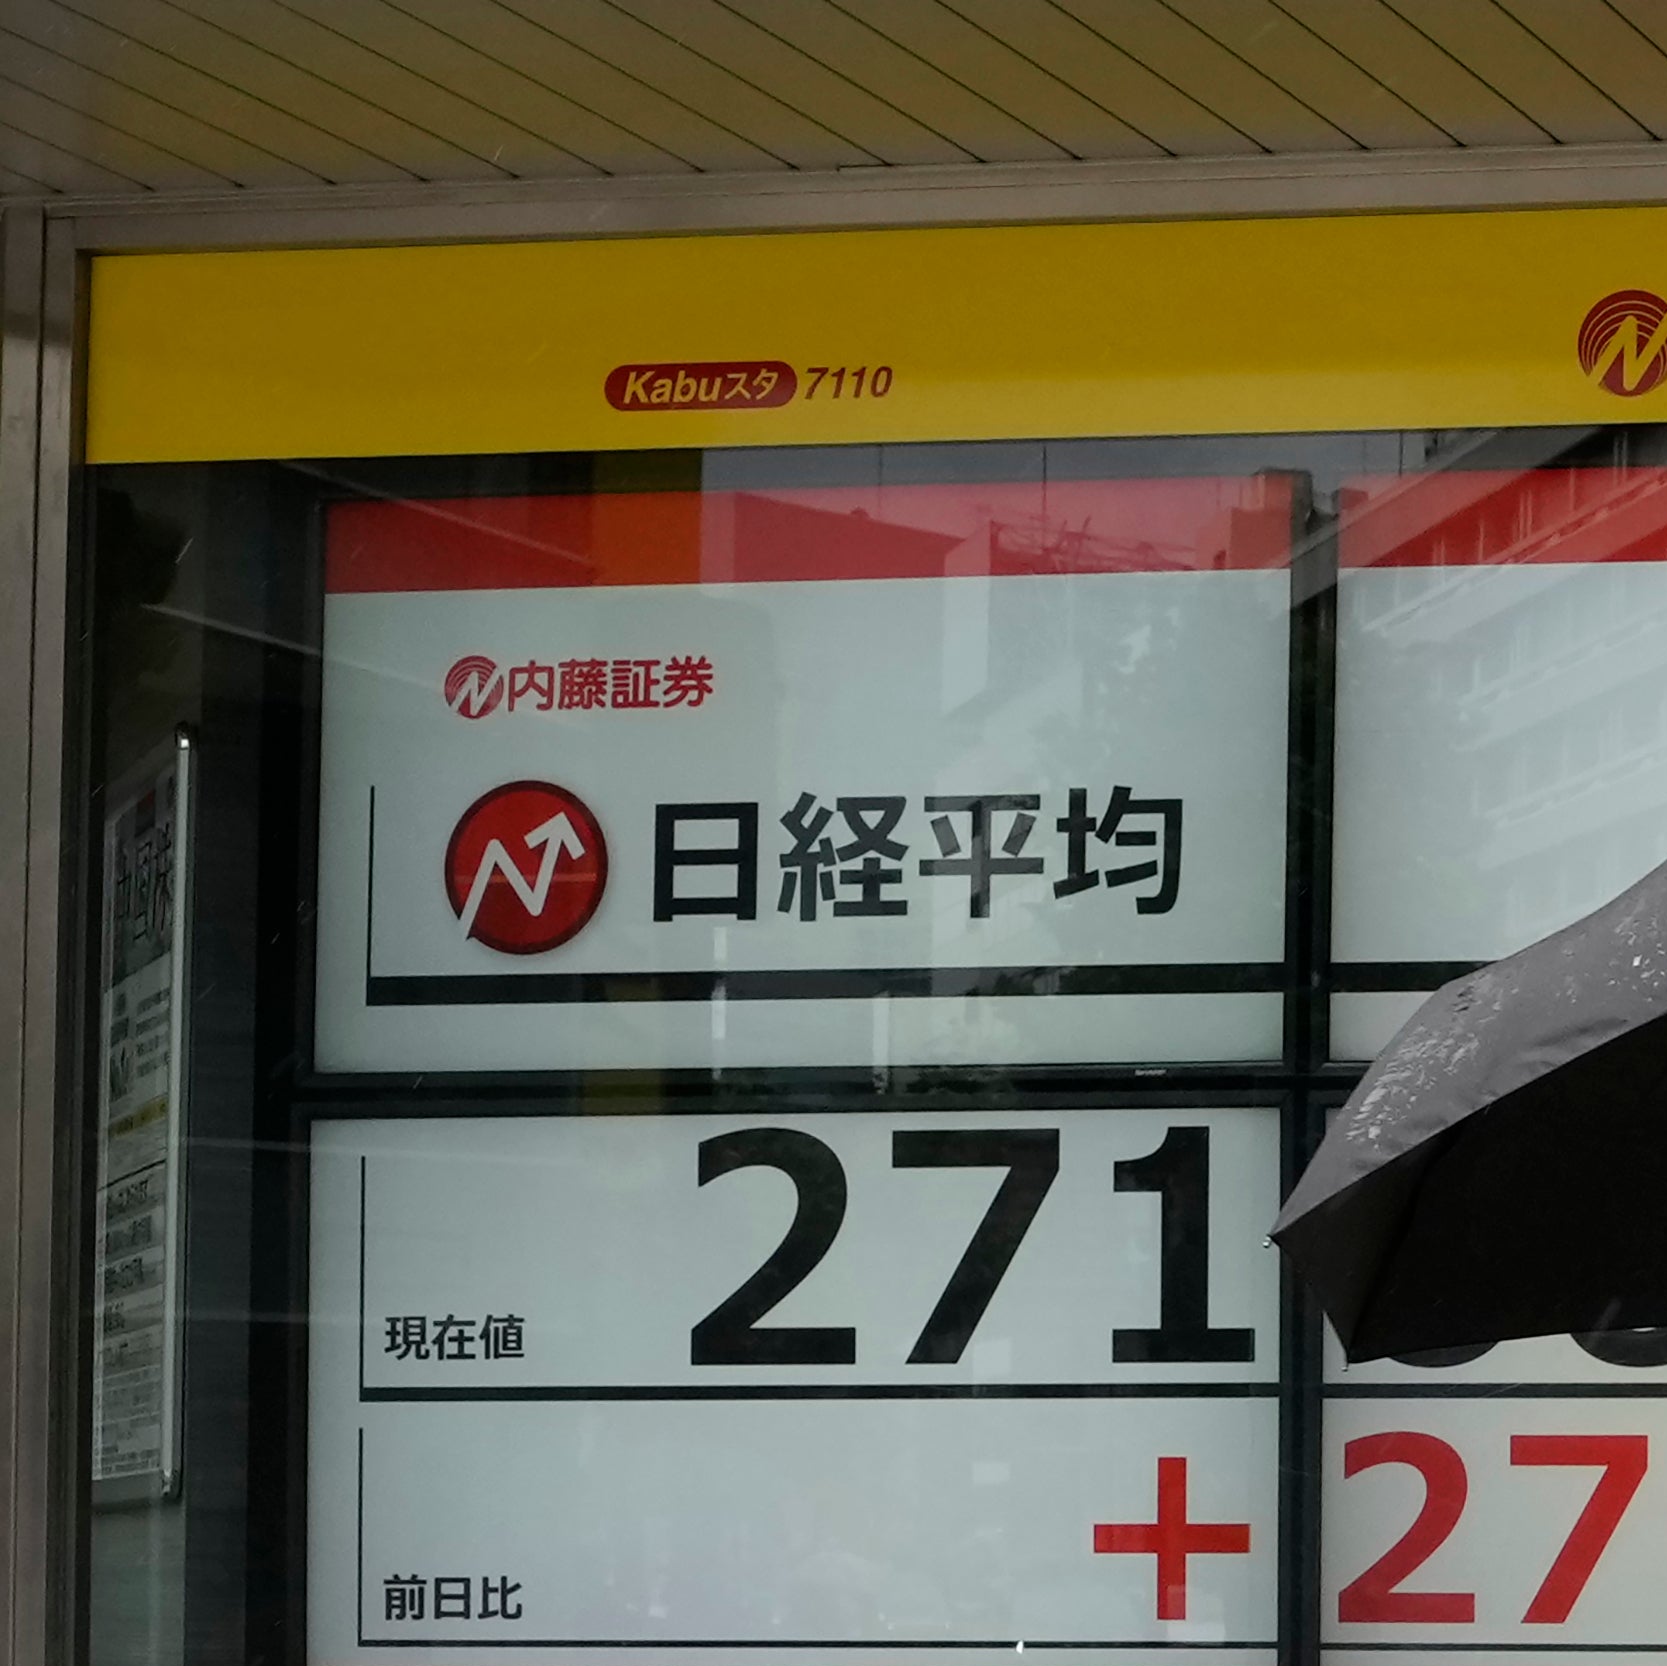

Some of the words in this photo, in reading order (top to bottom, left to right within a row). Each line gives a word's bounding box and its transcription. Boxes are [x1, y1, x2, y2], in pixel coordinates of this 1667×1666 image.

[623, 367, 779, 404] Kabuスタ
[804, 365, 893, 400] 7110
[508, 656, 713, 711] 内藤証券
[652, 785, 1184, 923] 日経平均
[384, 1314, 526, 1361] 現在値
[383, 1573, 523, 1621] 前日比
